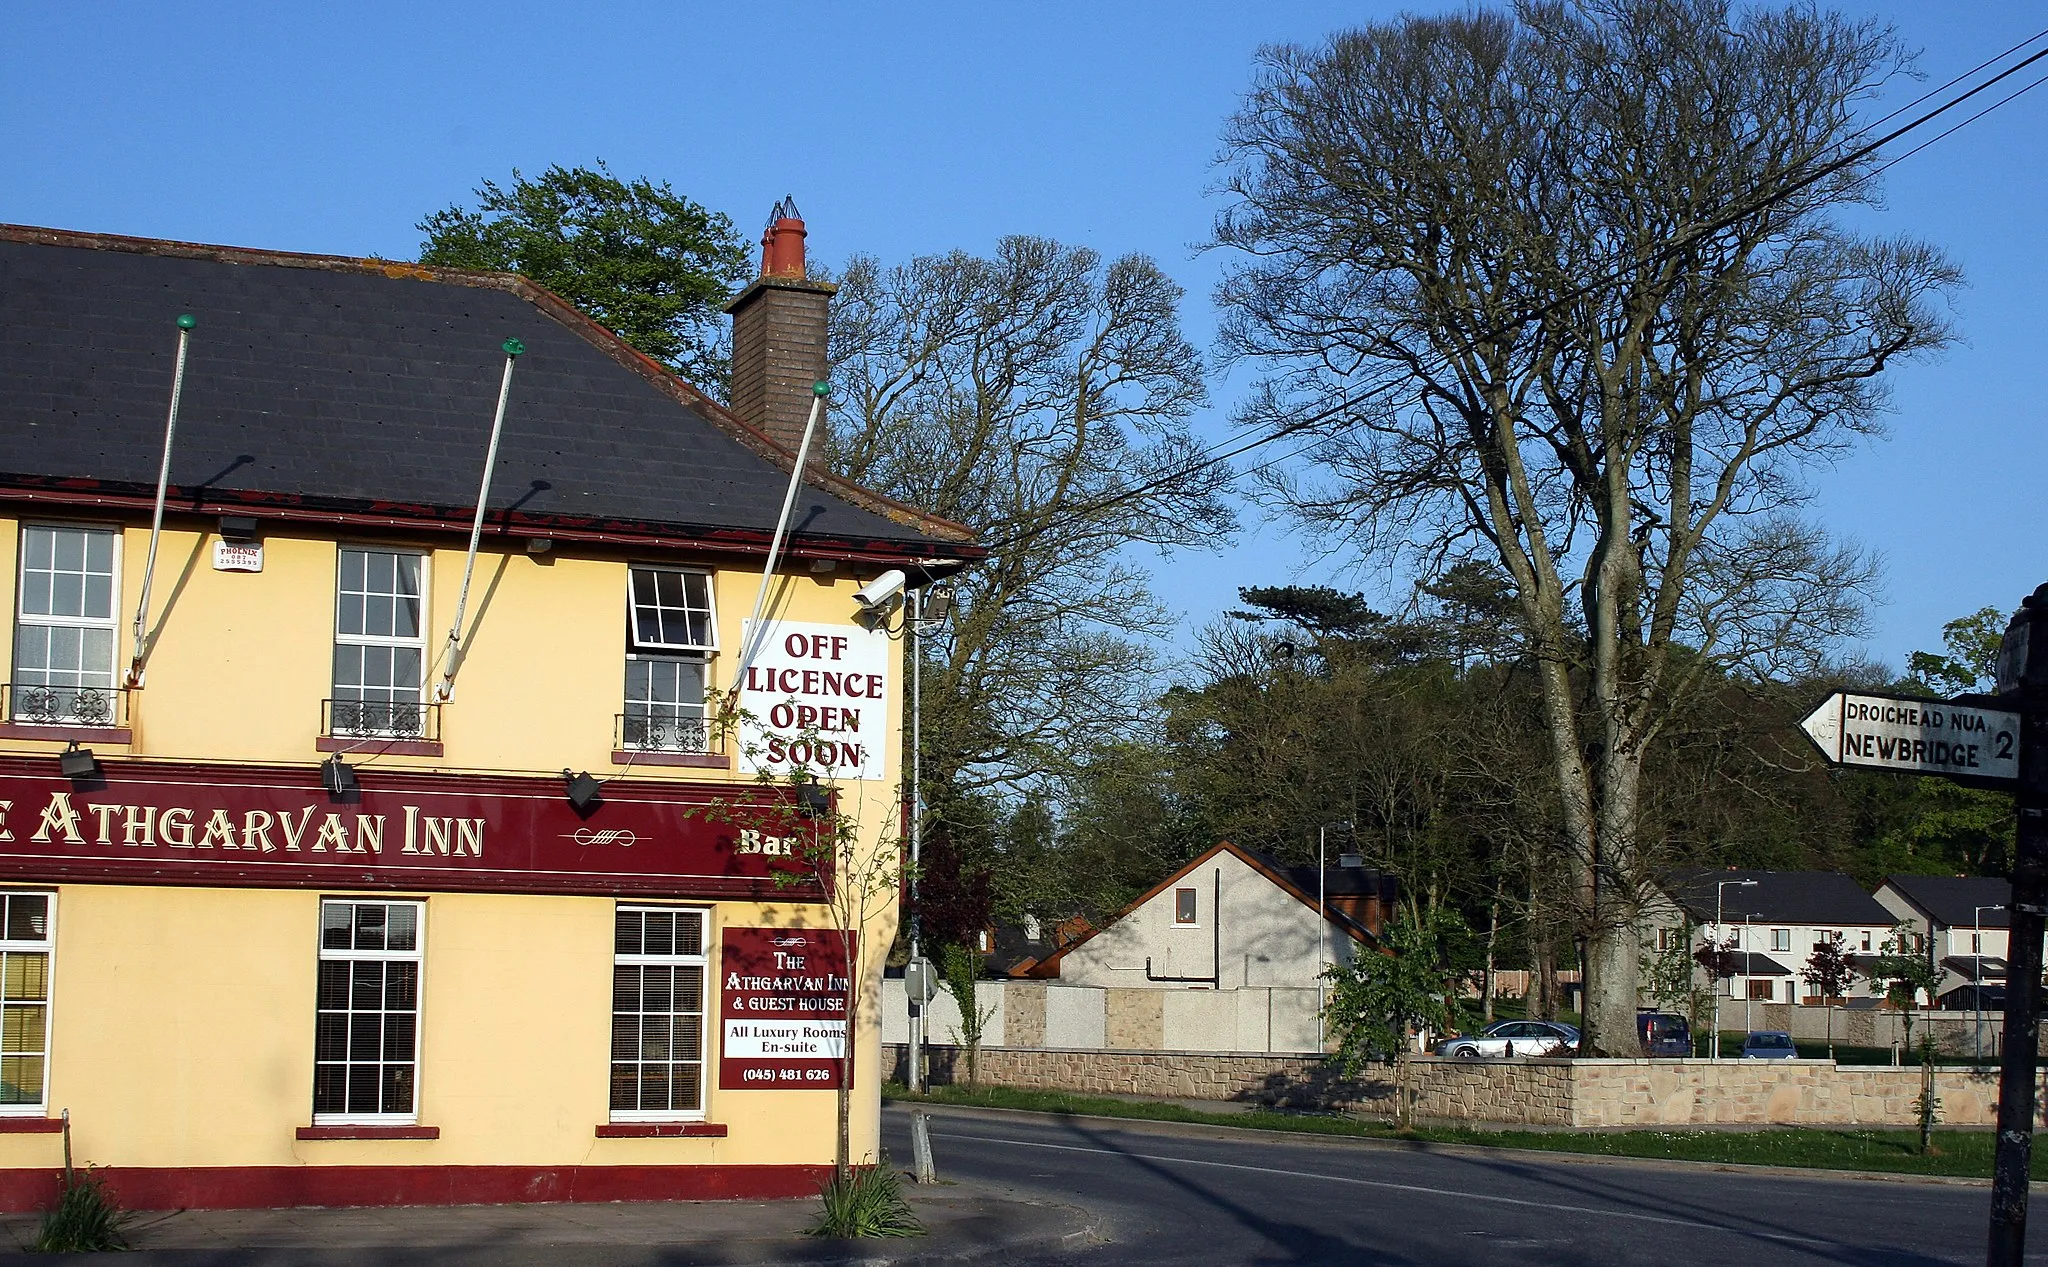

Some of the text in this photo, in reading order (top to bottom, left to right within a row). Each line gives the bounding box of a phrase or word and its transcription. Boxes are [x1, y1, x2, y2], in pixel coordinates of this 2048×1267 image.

[220, 547, 258, 556] PHOENIX
[785, 633, 848, 660] OFF
[747, 666, 883, 699] LICENCE
[770, 703, 861, 733] OPEN
[1847, 703, 1987, 733] DROICHEAD NUA
[766, 737, 861, 768] SOON
[1845, 730, 2014, 767] NEWBRIDGE 2
[30, 792, 386, 855] ATHGARVAN
[401, 805, 486, 858] INN
[738, 828, 797, 856] Bar
[773, 952, 806, 970] THE
[725, 972, 823, 991] ATHGARVAN
[732, 996, 844, 1011] & GUEST HOUSE
[730, 1026, 847, 1040] All Luxury Rooms
[761, 1041, 817, 1053] En-suite
[743, 1069, 830, 1082] (045) 481 626
